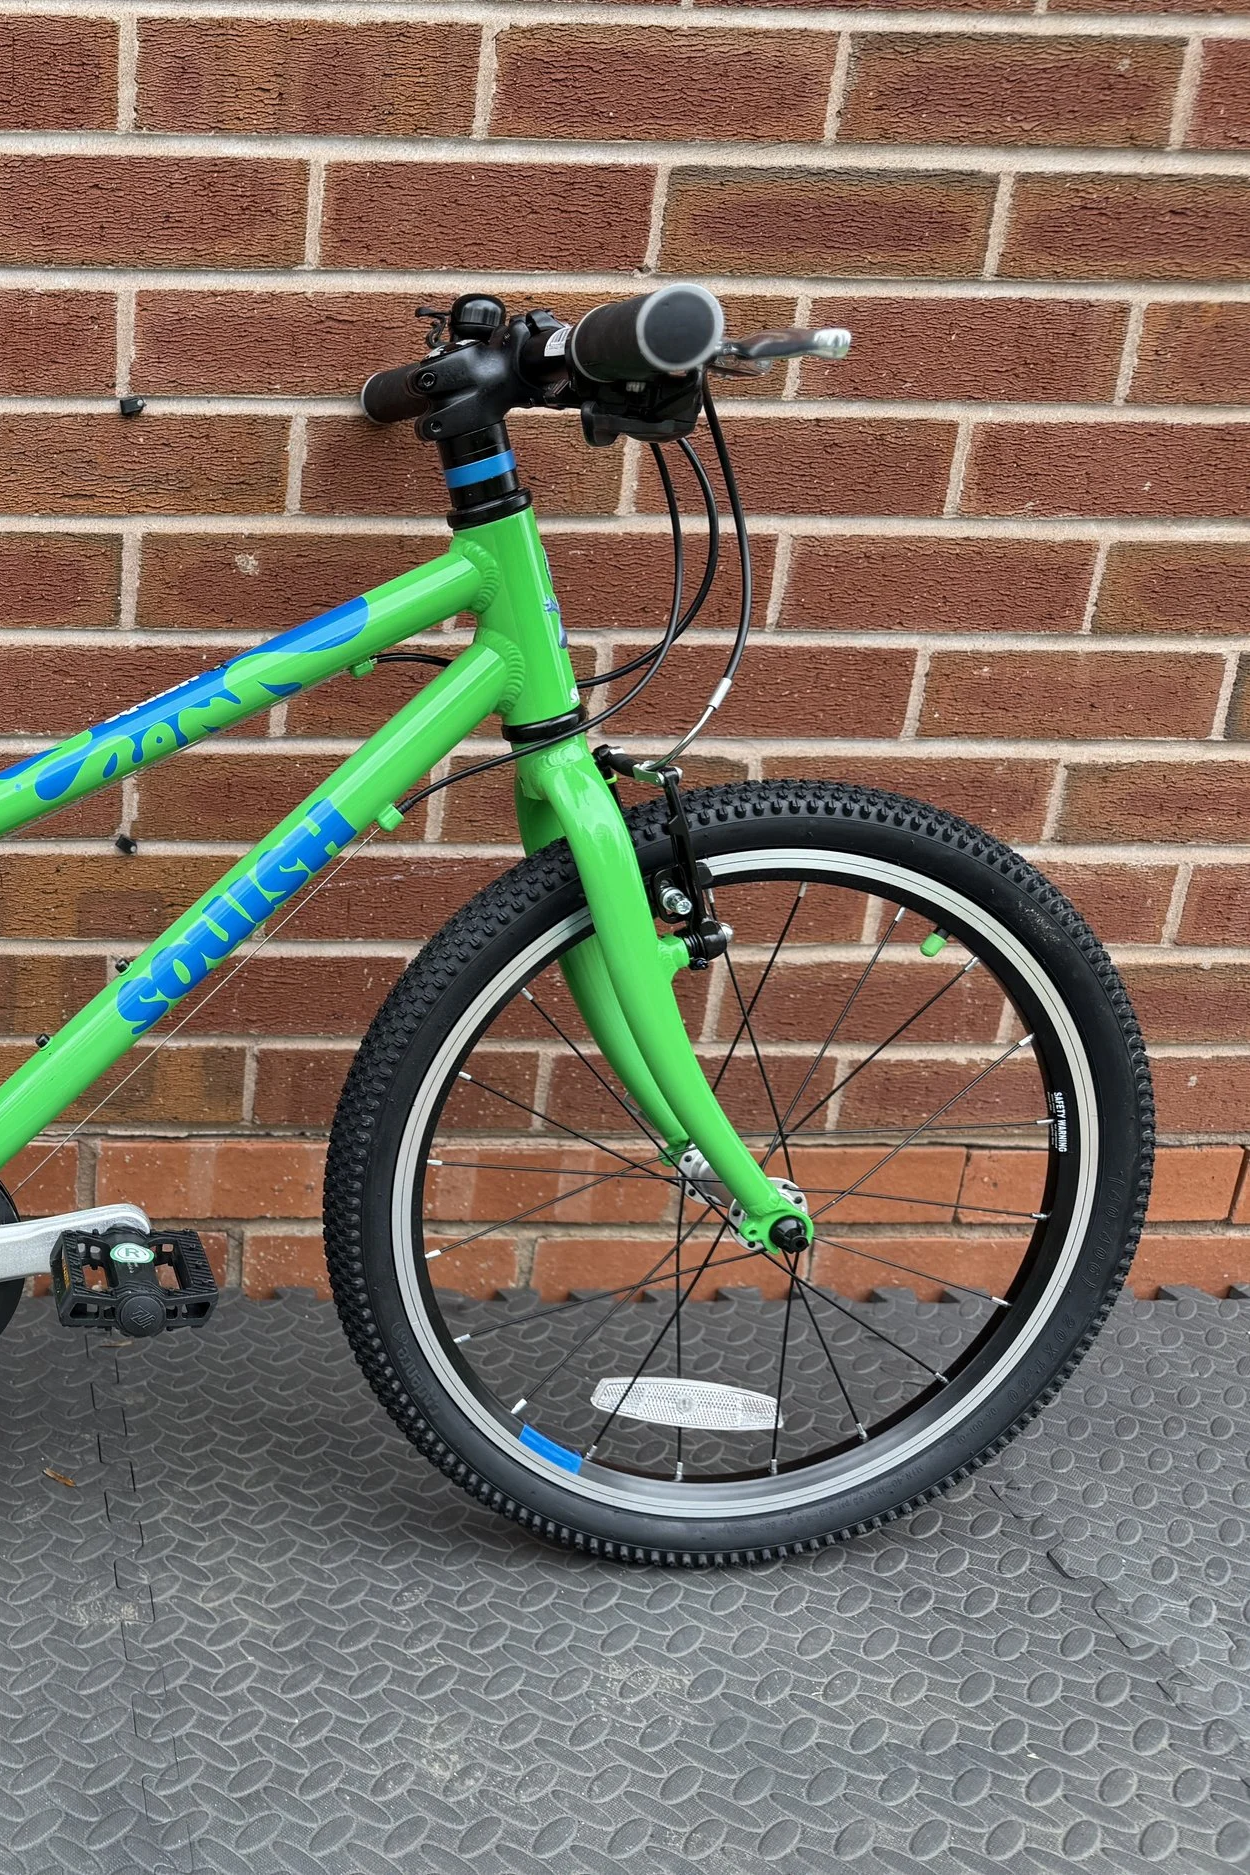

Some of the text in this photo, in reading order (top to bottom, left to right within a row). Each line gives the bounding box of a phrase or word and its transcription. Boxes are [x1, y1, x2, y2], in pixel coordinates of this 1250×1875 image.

[117, 798, 358, 1035] SQUISH
[1054, 1092, 1066, 1118] SAFETY
[1058, 1120, 1067, 1152] WARNING
[125, 1247, 139, 1258] R
